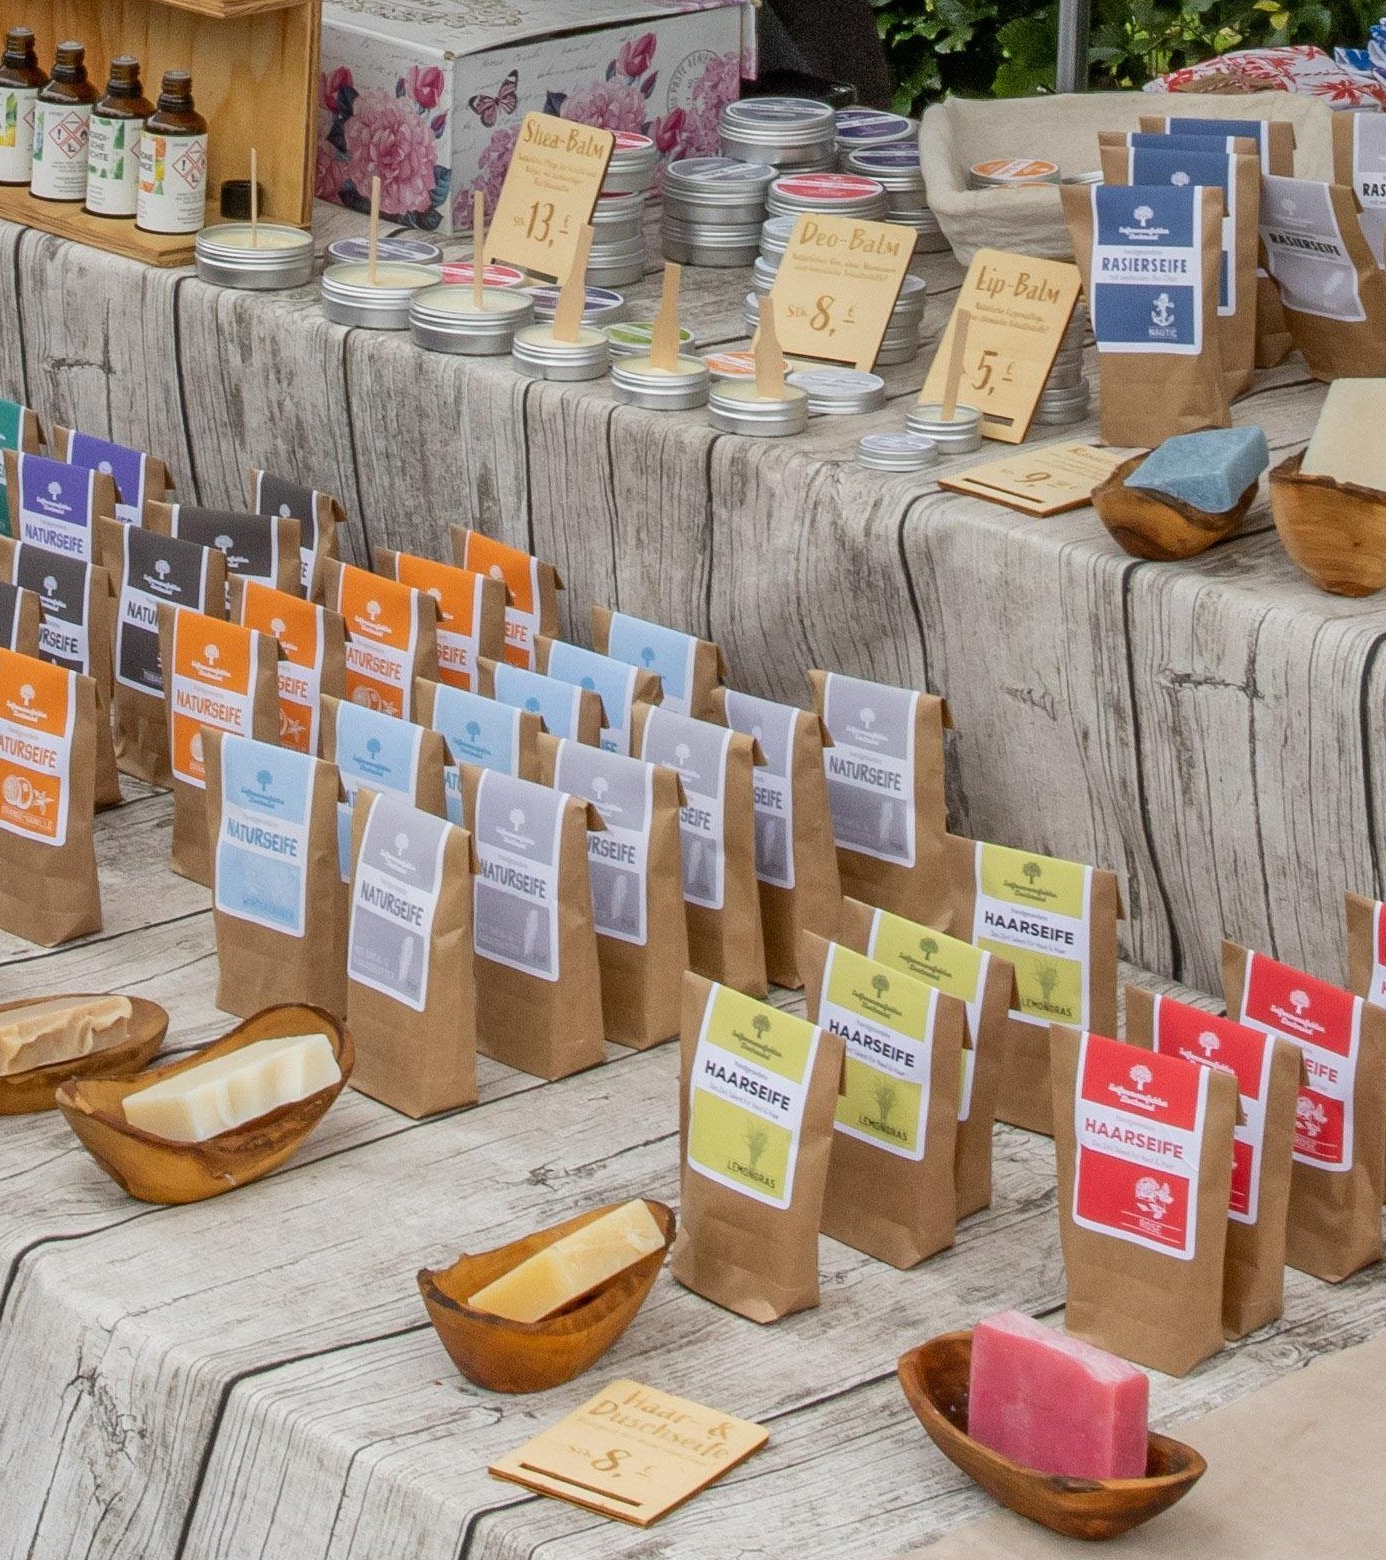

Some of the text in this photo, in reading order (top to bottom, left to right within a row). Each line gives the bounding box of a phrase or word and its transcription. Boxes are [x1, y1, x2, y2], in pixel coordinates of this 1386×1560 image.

[1269, 232, 1342, 257] RASIERSEIFE
[1101, 256, 1188, 274] RASIERSEIFE
[24, 523, 84, 555] NATURSEIFE
[345, 646, 403, 681] ATURSEIFE
[176, 688, 242, 727] NATURSEIFE
[828, 755, 903, 792] NATURSEIFE
[226, 816, 299, 858] NATURSEIFE
[478, 858, 548, 900] NATURSEIFE
[359, 878, 425, 928] NATURSEIFE
[984, 910, 1075, 946] HAARSEIFE
[828, 1018, 916, 1069] HAARSEIFE
[704, 1060, 792, 1112] HAARSEIFE
[1084, 1116, 1184, 1160] HAARSEIFE
